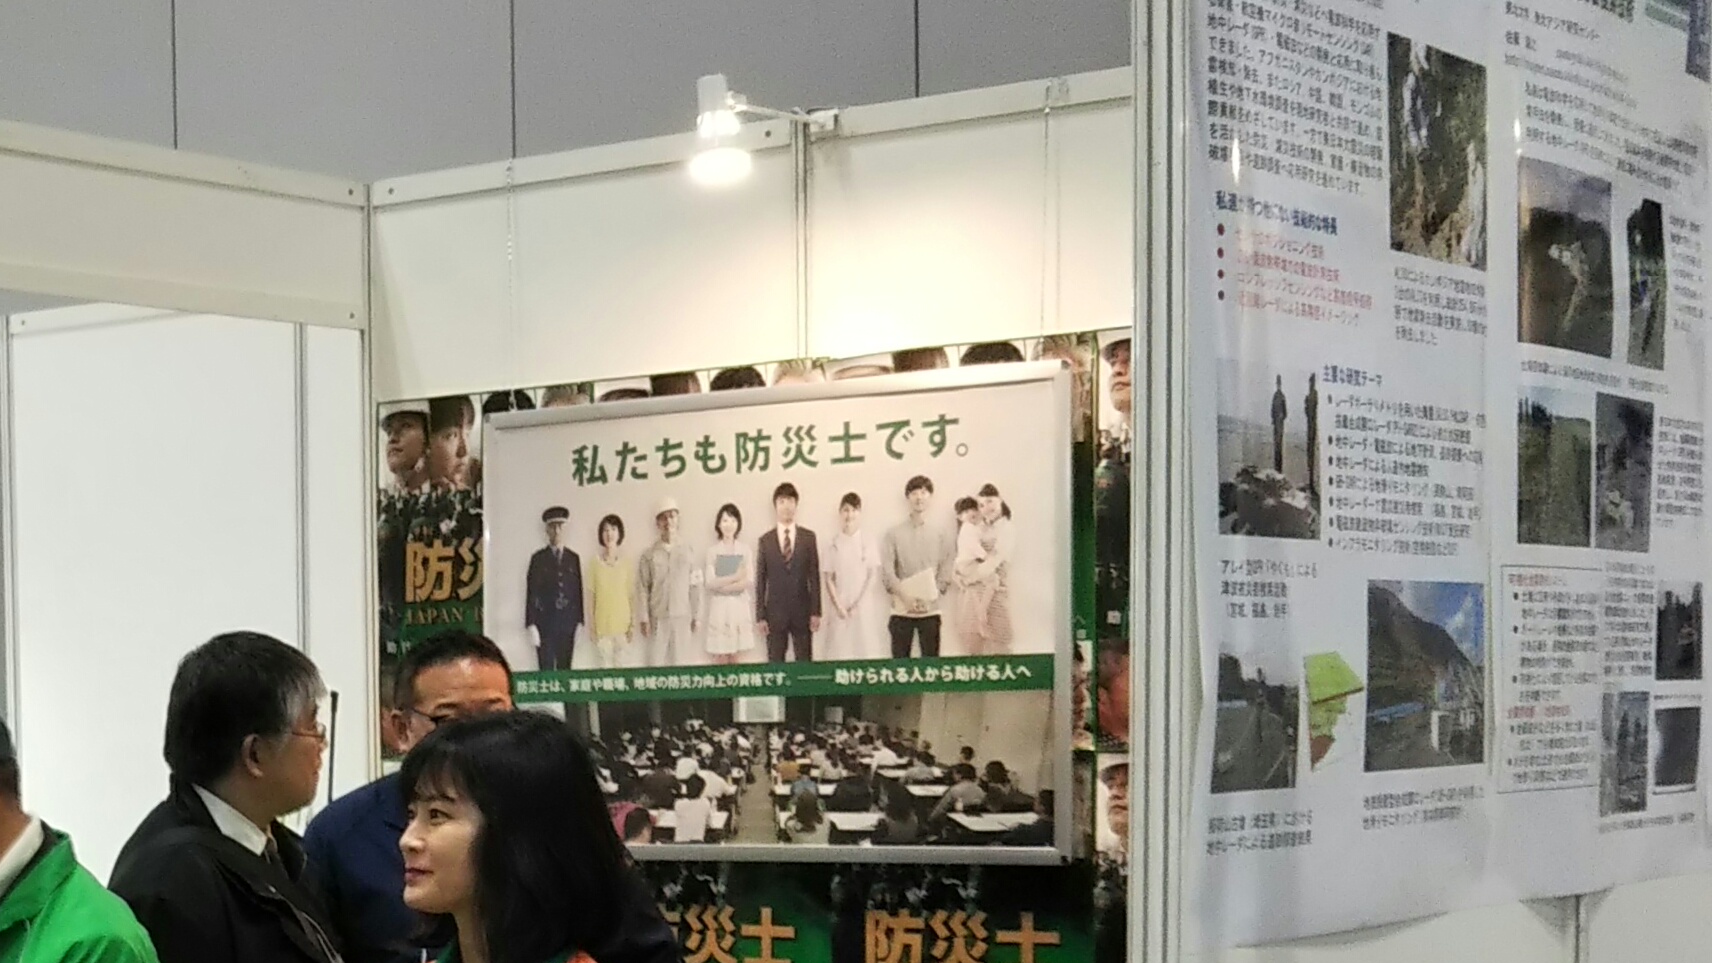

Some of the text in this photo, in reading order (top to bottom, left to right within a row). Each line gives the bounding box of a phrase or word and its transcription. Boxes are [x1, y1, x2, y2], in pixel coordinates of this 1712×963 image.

[571, 413, 969, 487] 私たちも防災士です。
